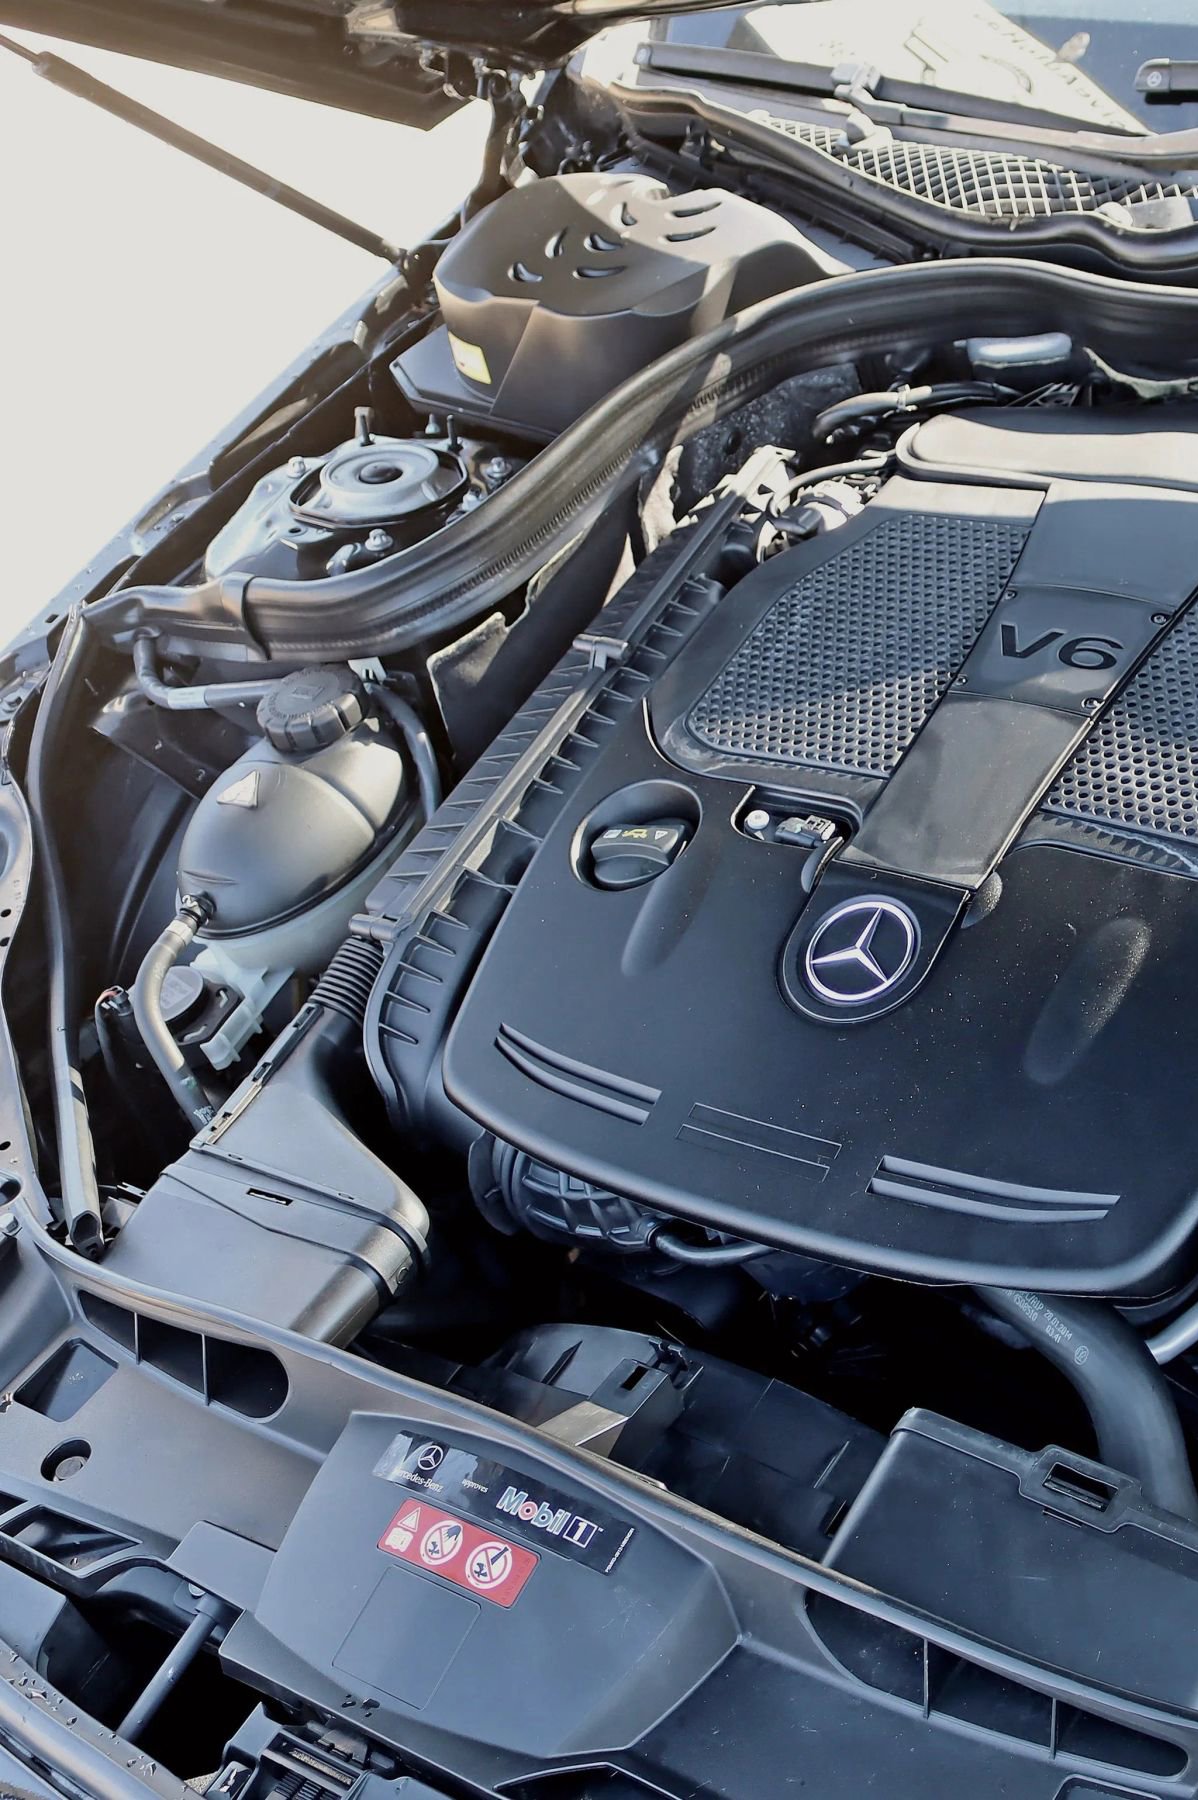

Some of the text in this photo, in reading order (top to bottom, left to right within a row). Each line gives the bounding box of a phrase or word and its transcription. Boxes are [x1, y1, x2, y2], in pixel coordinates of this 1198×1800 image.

[1000, 623, 1124, 670] V6
[394, 1468, 444, 1493] ercedes-Benz
[461, 1479, 489, 1493] approves
[496, 1486, 572, 1535] Mobil
